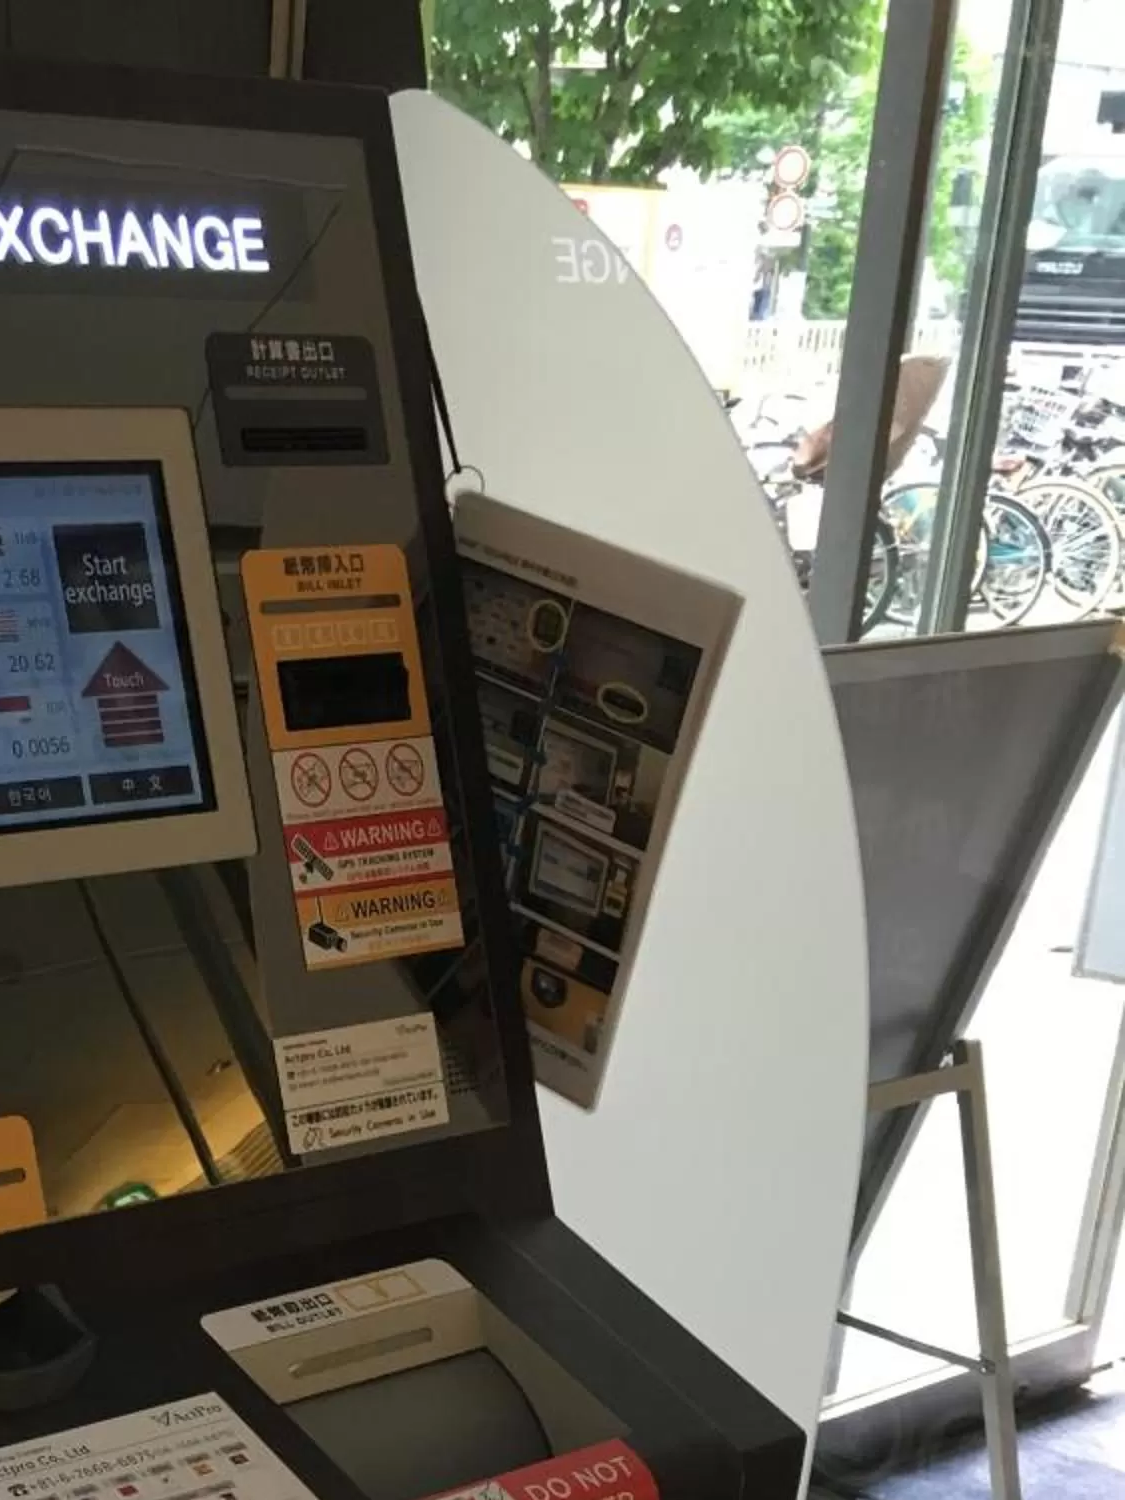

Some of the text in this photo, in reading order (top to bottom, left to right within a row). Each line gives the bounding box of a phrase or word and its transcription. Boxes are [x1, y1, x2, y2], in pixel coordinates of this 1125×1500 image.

[300, 366, 347, 380] OUTLET
[82, 553, 127, 577] Start
[65, 580, 155, 606] exchange
[103, 671, 145, 689] Touch
[339, 819, 426, 850] WARNING
[350, 890, 436, 919] WARNING
[296, 1307, 344, 1325] OUTLET
[570, 1455, 632, 1492] NOT
